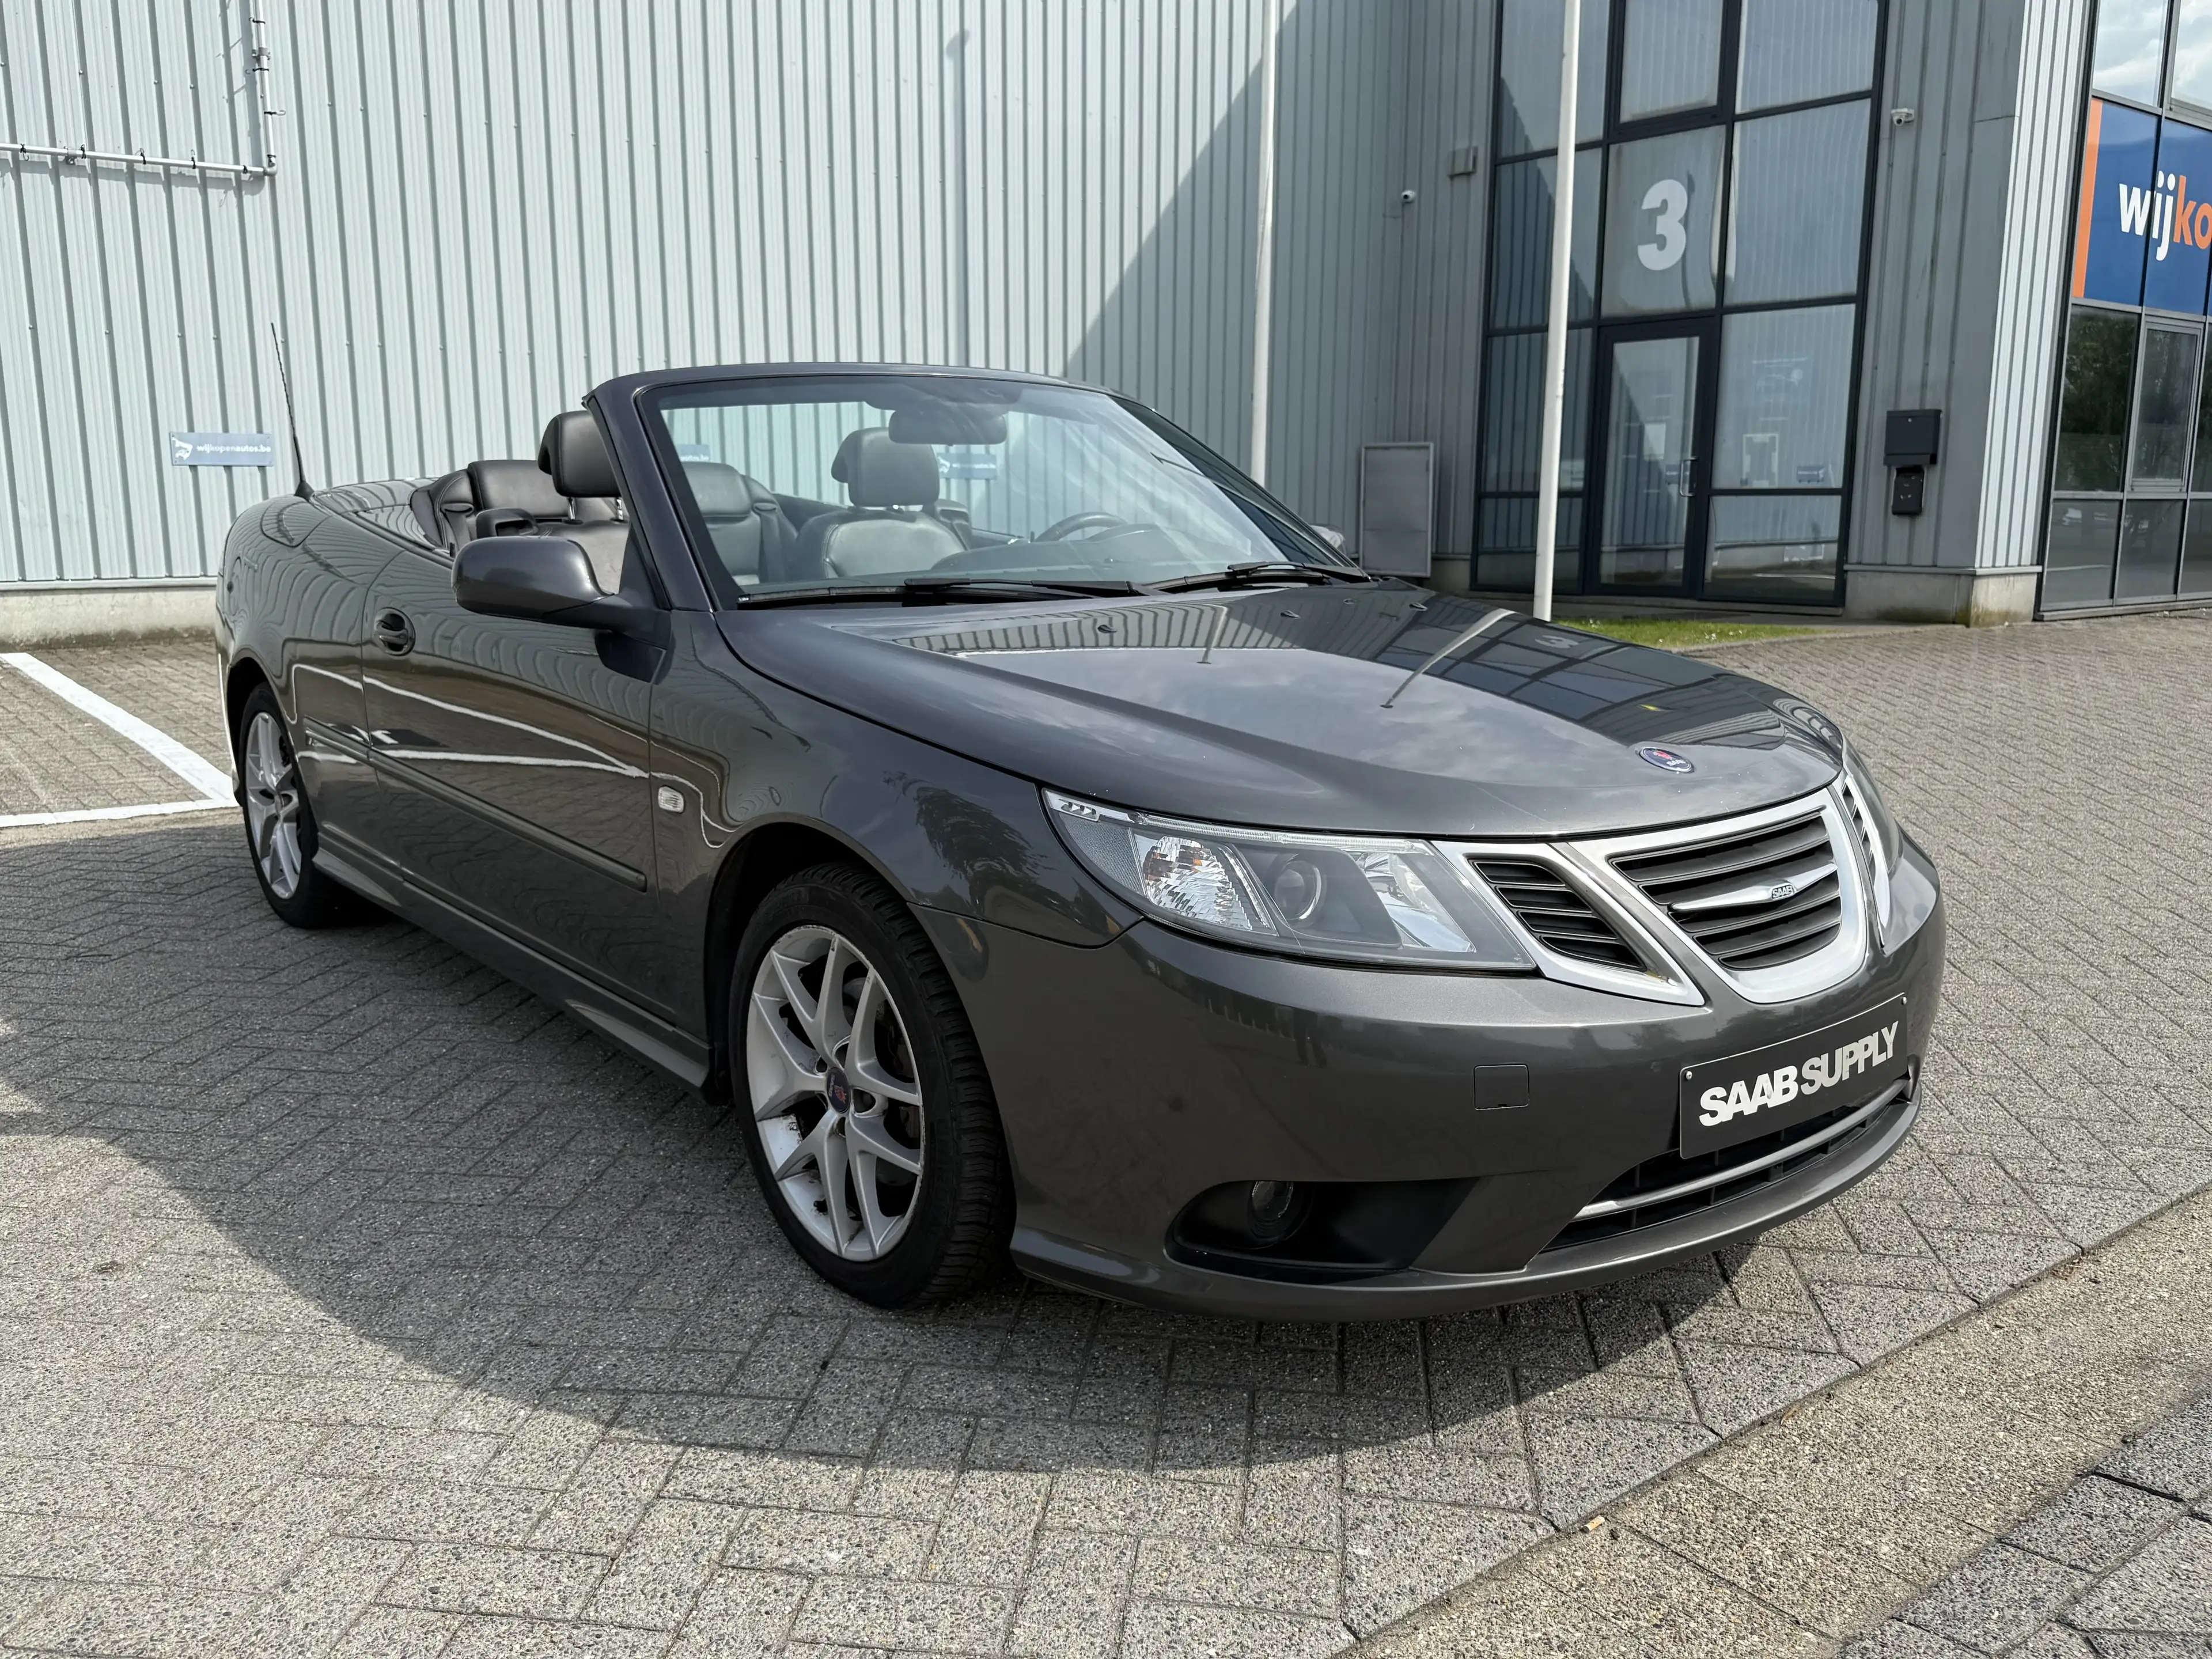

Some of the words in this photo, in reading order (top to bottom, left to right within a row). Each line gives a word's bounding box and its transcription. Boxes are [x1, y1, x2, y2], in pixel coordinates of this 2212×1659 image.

[1637, 179, 1687, 271] 3
[2119, 171, 2212, 261] wijko
[196, 444, 271, 453] wijkopenautos.be
[1772, 885, 1792, 898] SAAB
[1699, 1065, 1797, 1127] SAAB
[1801, 1021, 1899, 1095] SUPPLY
